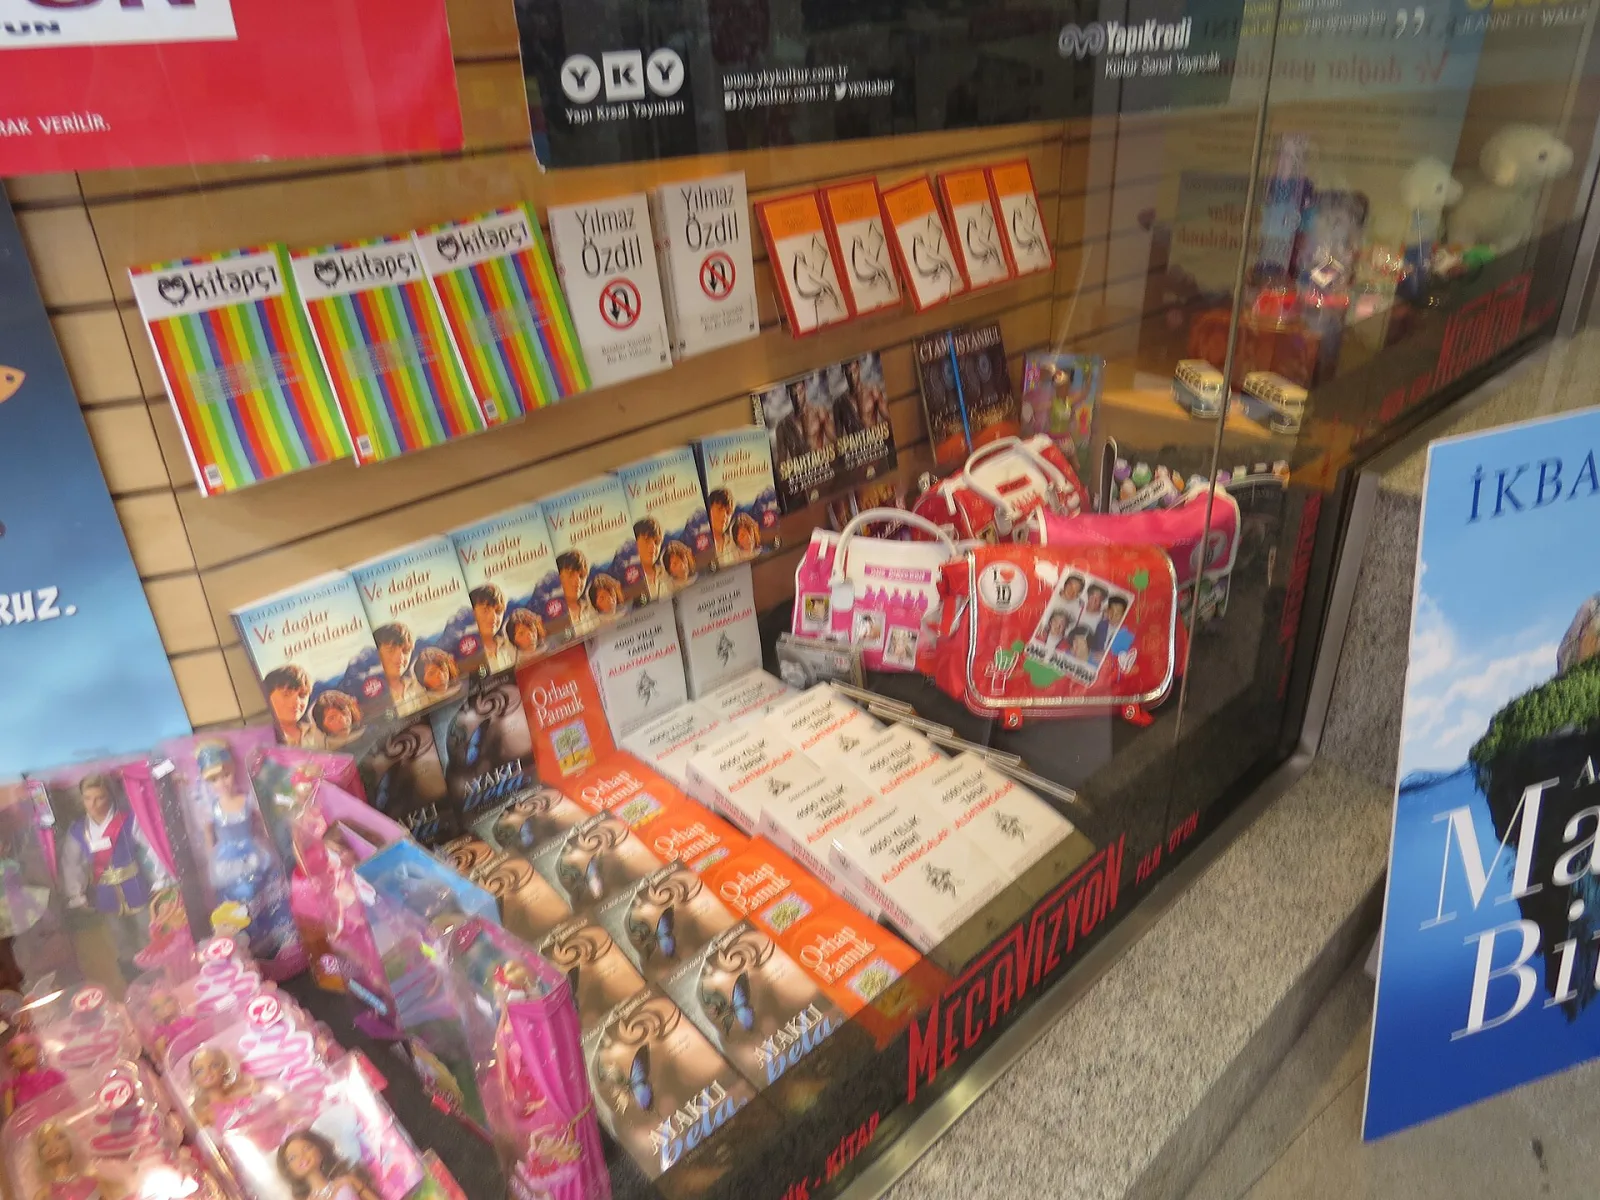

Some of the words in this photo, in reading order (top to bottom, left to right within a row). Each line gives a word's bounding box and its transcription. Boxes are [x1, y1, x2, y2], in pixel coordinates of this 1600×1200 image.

[0, 21, 61, 36] UN
[709, 451, 719, 468] Ve
[628, 480, 641, 499] Ve
[549, 512, 564, 531] Ve
[460, 545, 477, 565] Ve
[364, 582, 382, 602] Ve
[254, 624, 275, 644] Ve
[1573, 753, 1600, 790] A
[1449, 899, 1600, 1042] Bi
